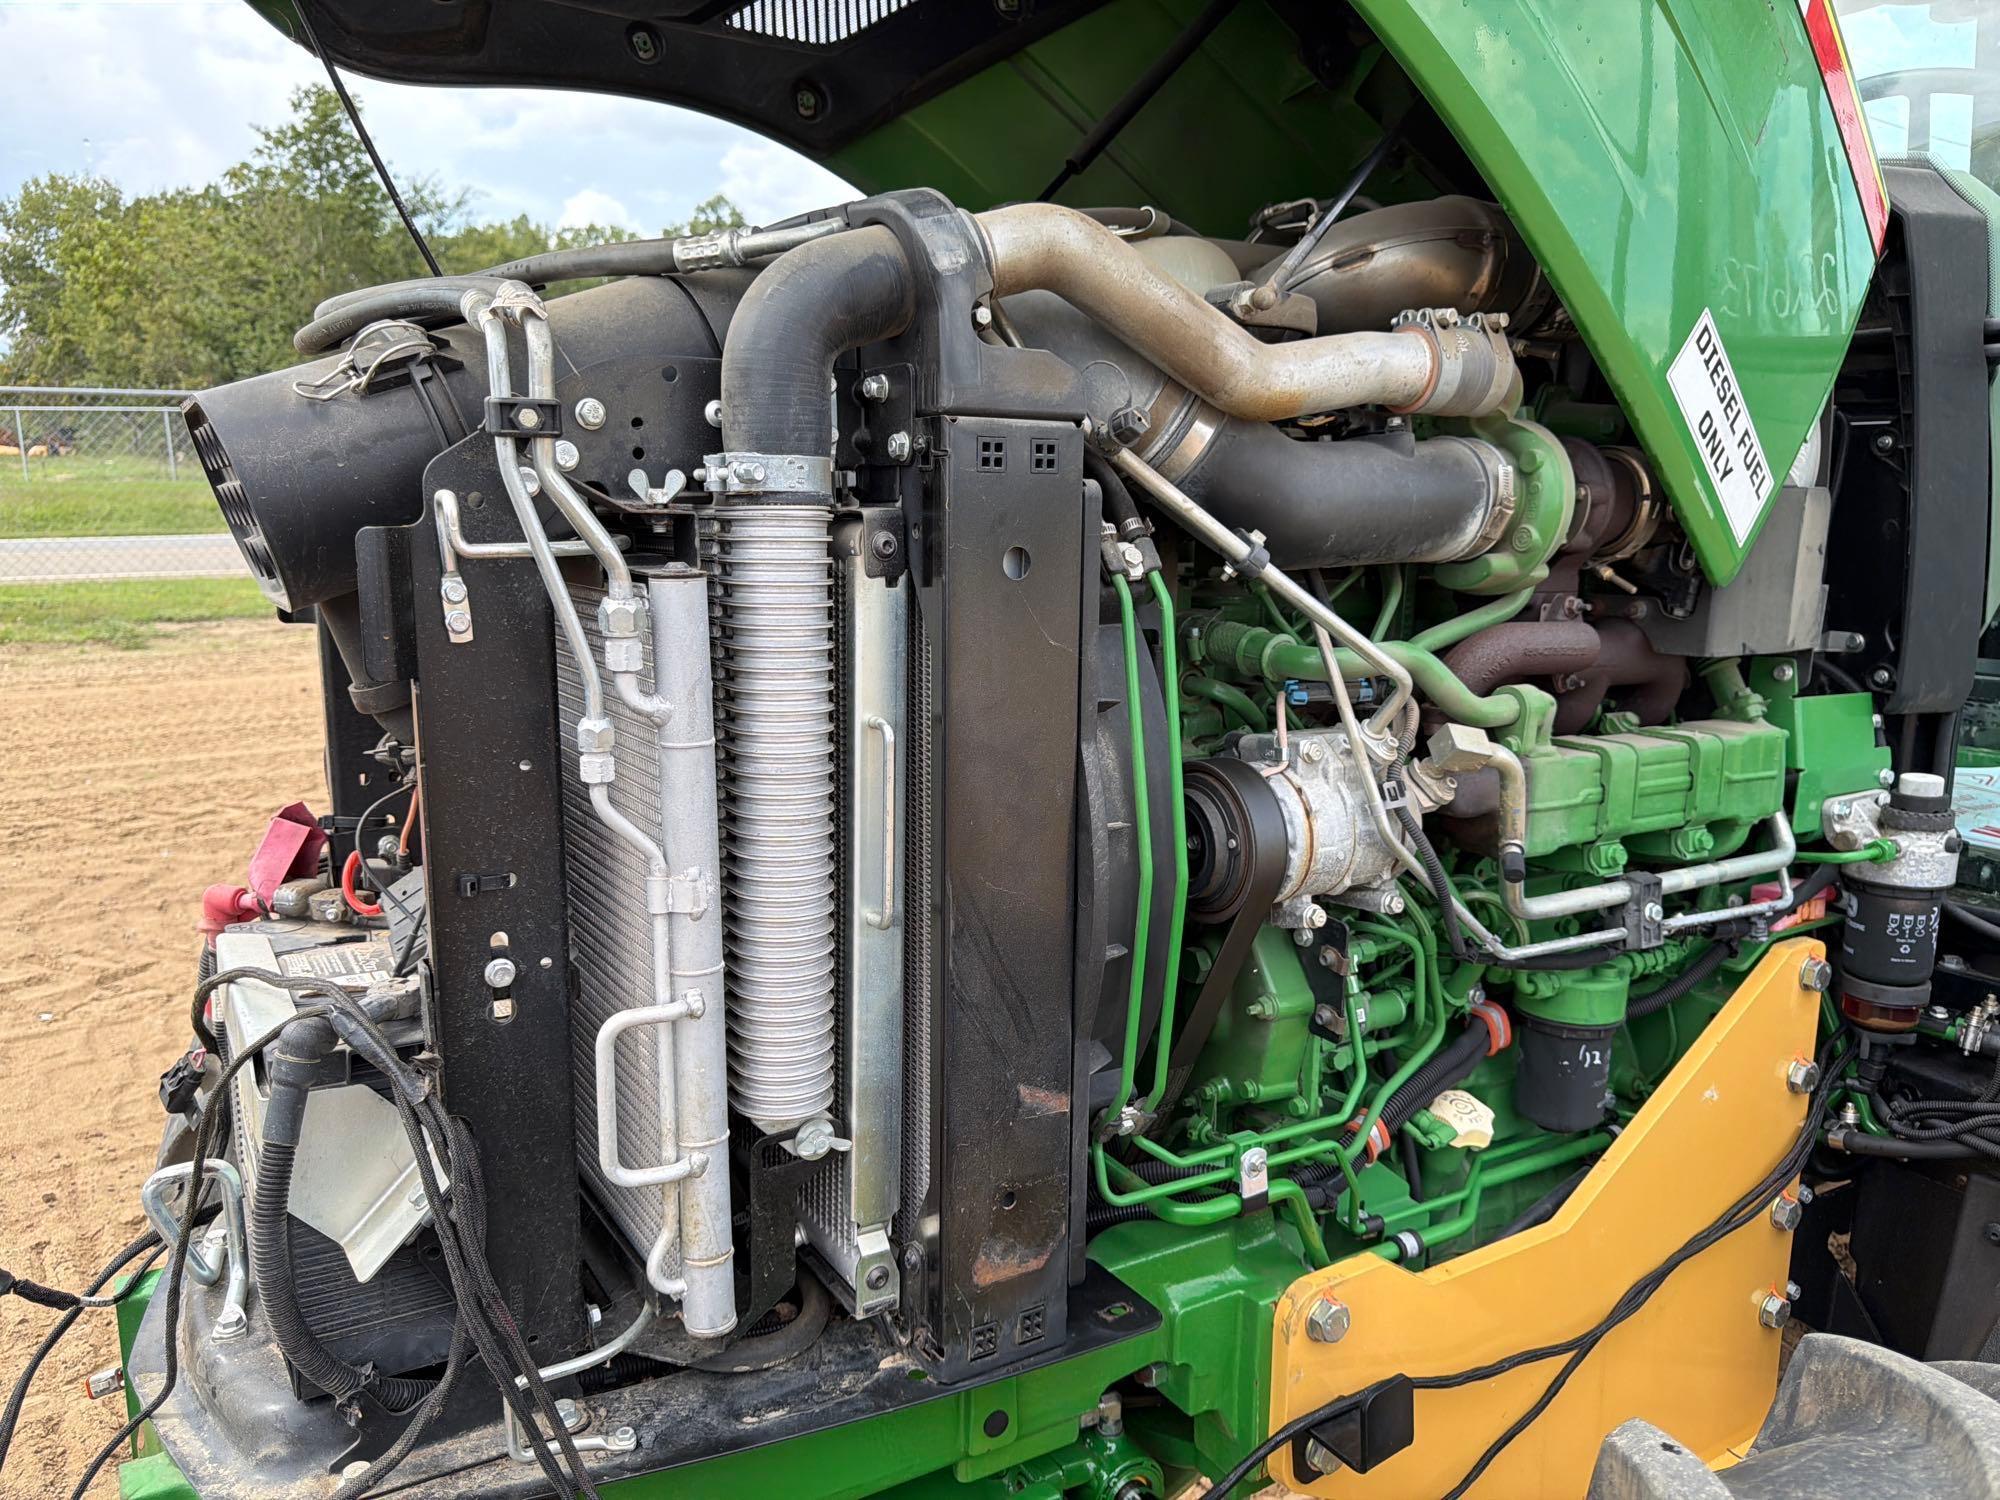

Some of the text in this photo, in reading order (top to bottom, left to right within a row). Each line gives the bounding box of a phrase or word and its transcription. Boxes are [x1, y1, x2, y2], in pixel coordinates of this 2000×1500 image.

[1695, 323, 1766, 501] DIESEL FUEL
[1698, 409, 1734, 483] ONLY
